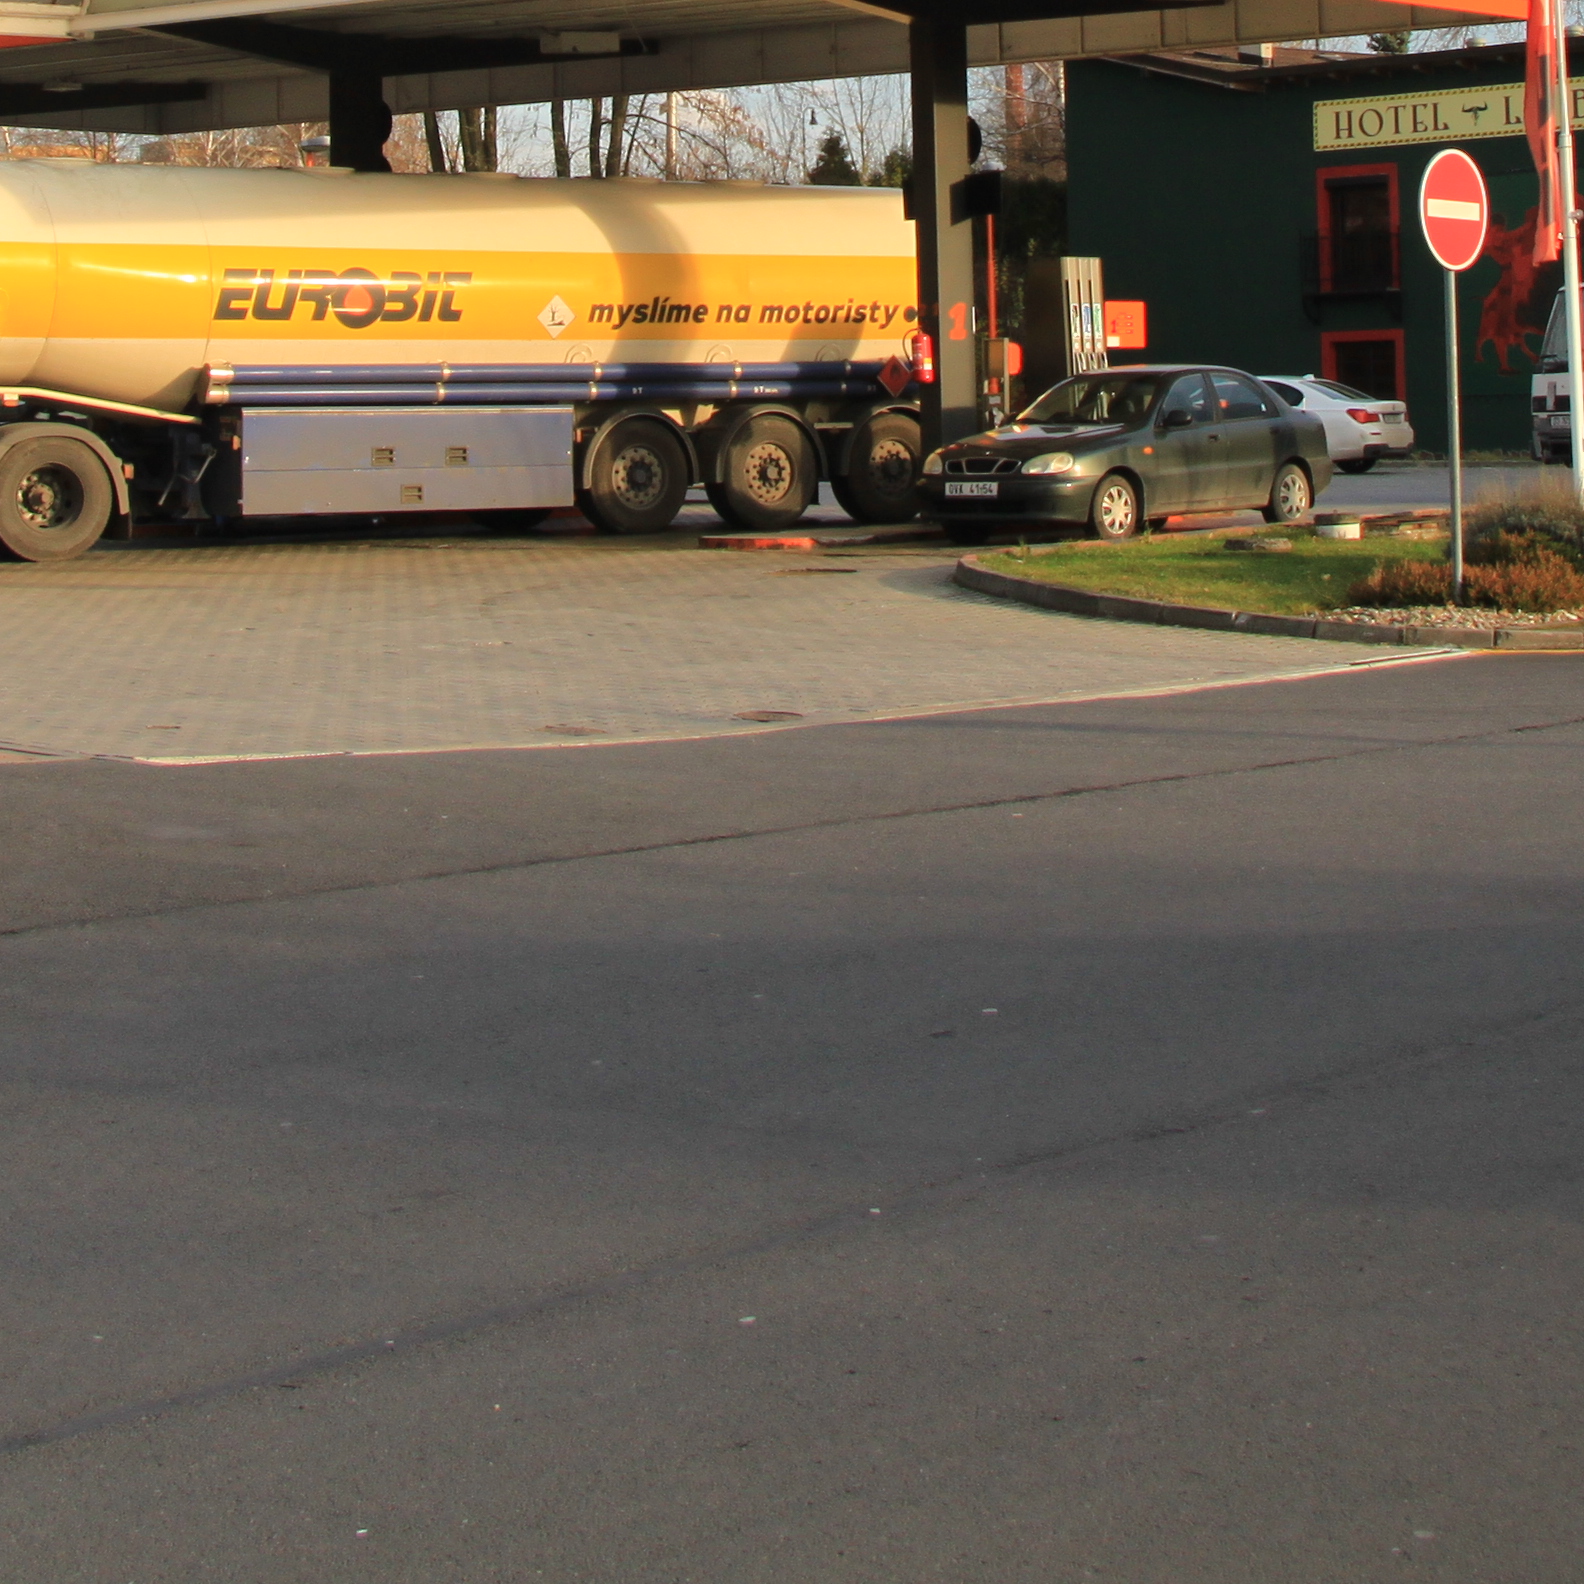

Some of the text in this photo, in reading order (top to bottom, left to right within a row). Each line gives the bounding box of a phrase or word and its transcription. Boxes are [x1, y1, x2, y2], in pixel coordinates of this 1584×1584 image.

[1333, 103, 1450, 141] HOTEL
[1503, 96, 1522, 125] L
[587, 296, 899, 330] myslíme na motoristy
